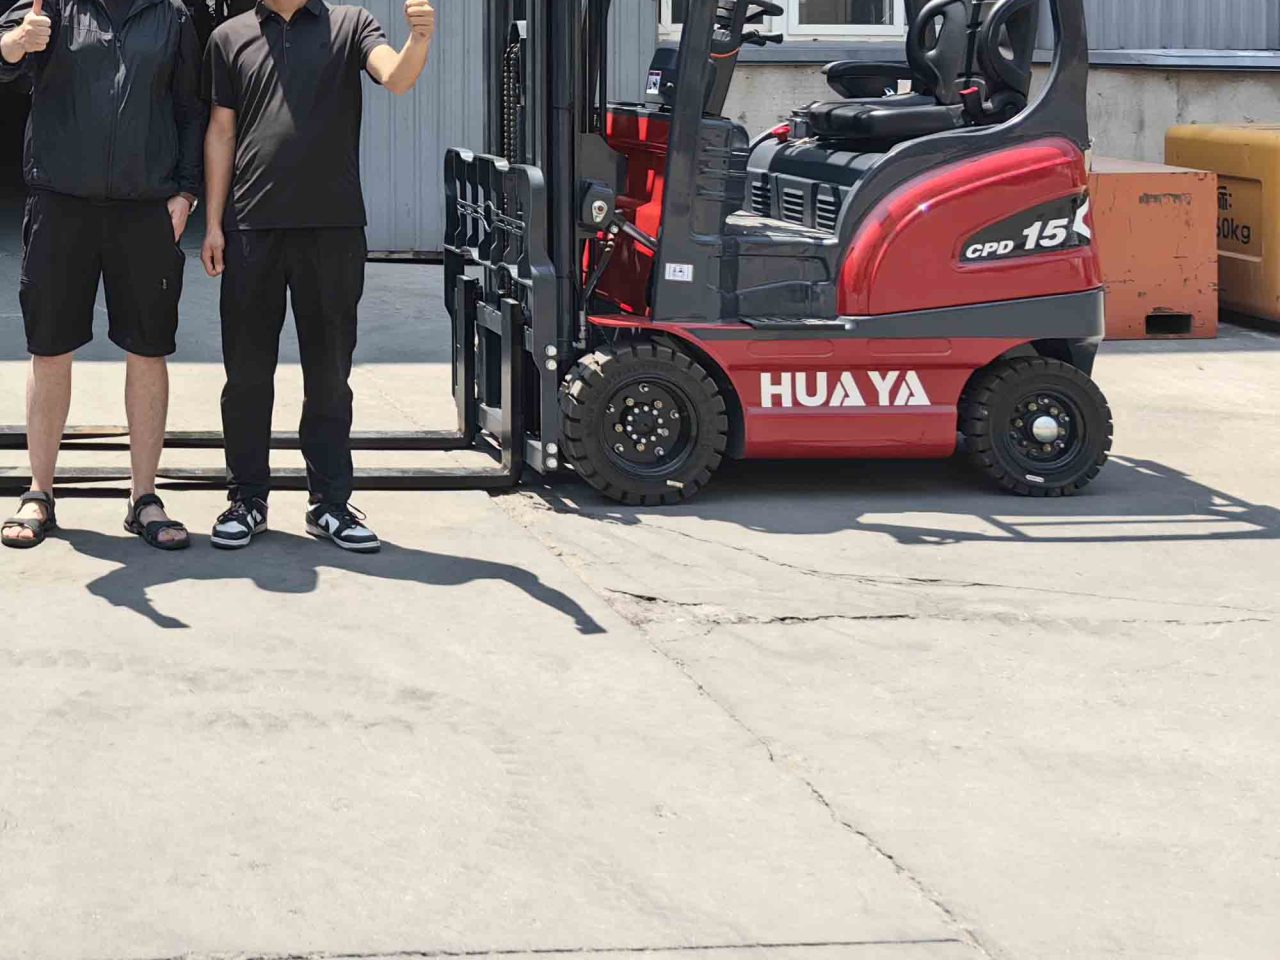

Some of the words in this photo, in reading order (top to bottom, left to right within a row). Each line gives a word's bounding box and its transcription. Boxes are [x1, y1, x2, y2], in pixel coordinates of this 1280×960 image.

[965, 240, 1015, 260] CPD
[1022, 217, 1069, 250] 15
[760, 370, 932, 408] HUAYA
